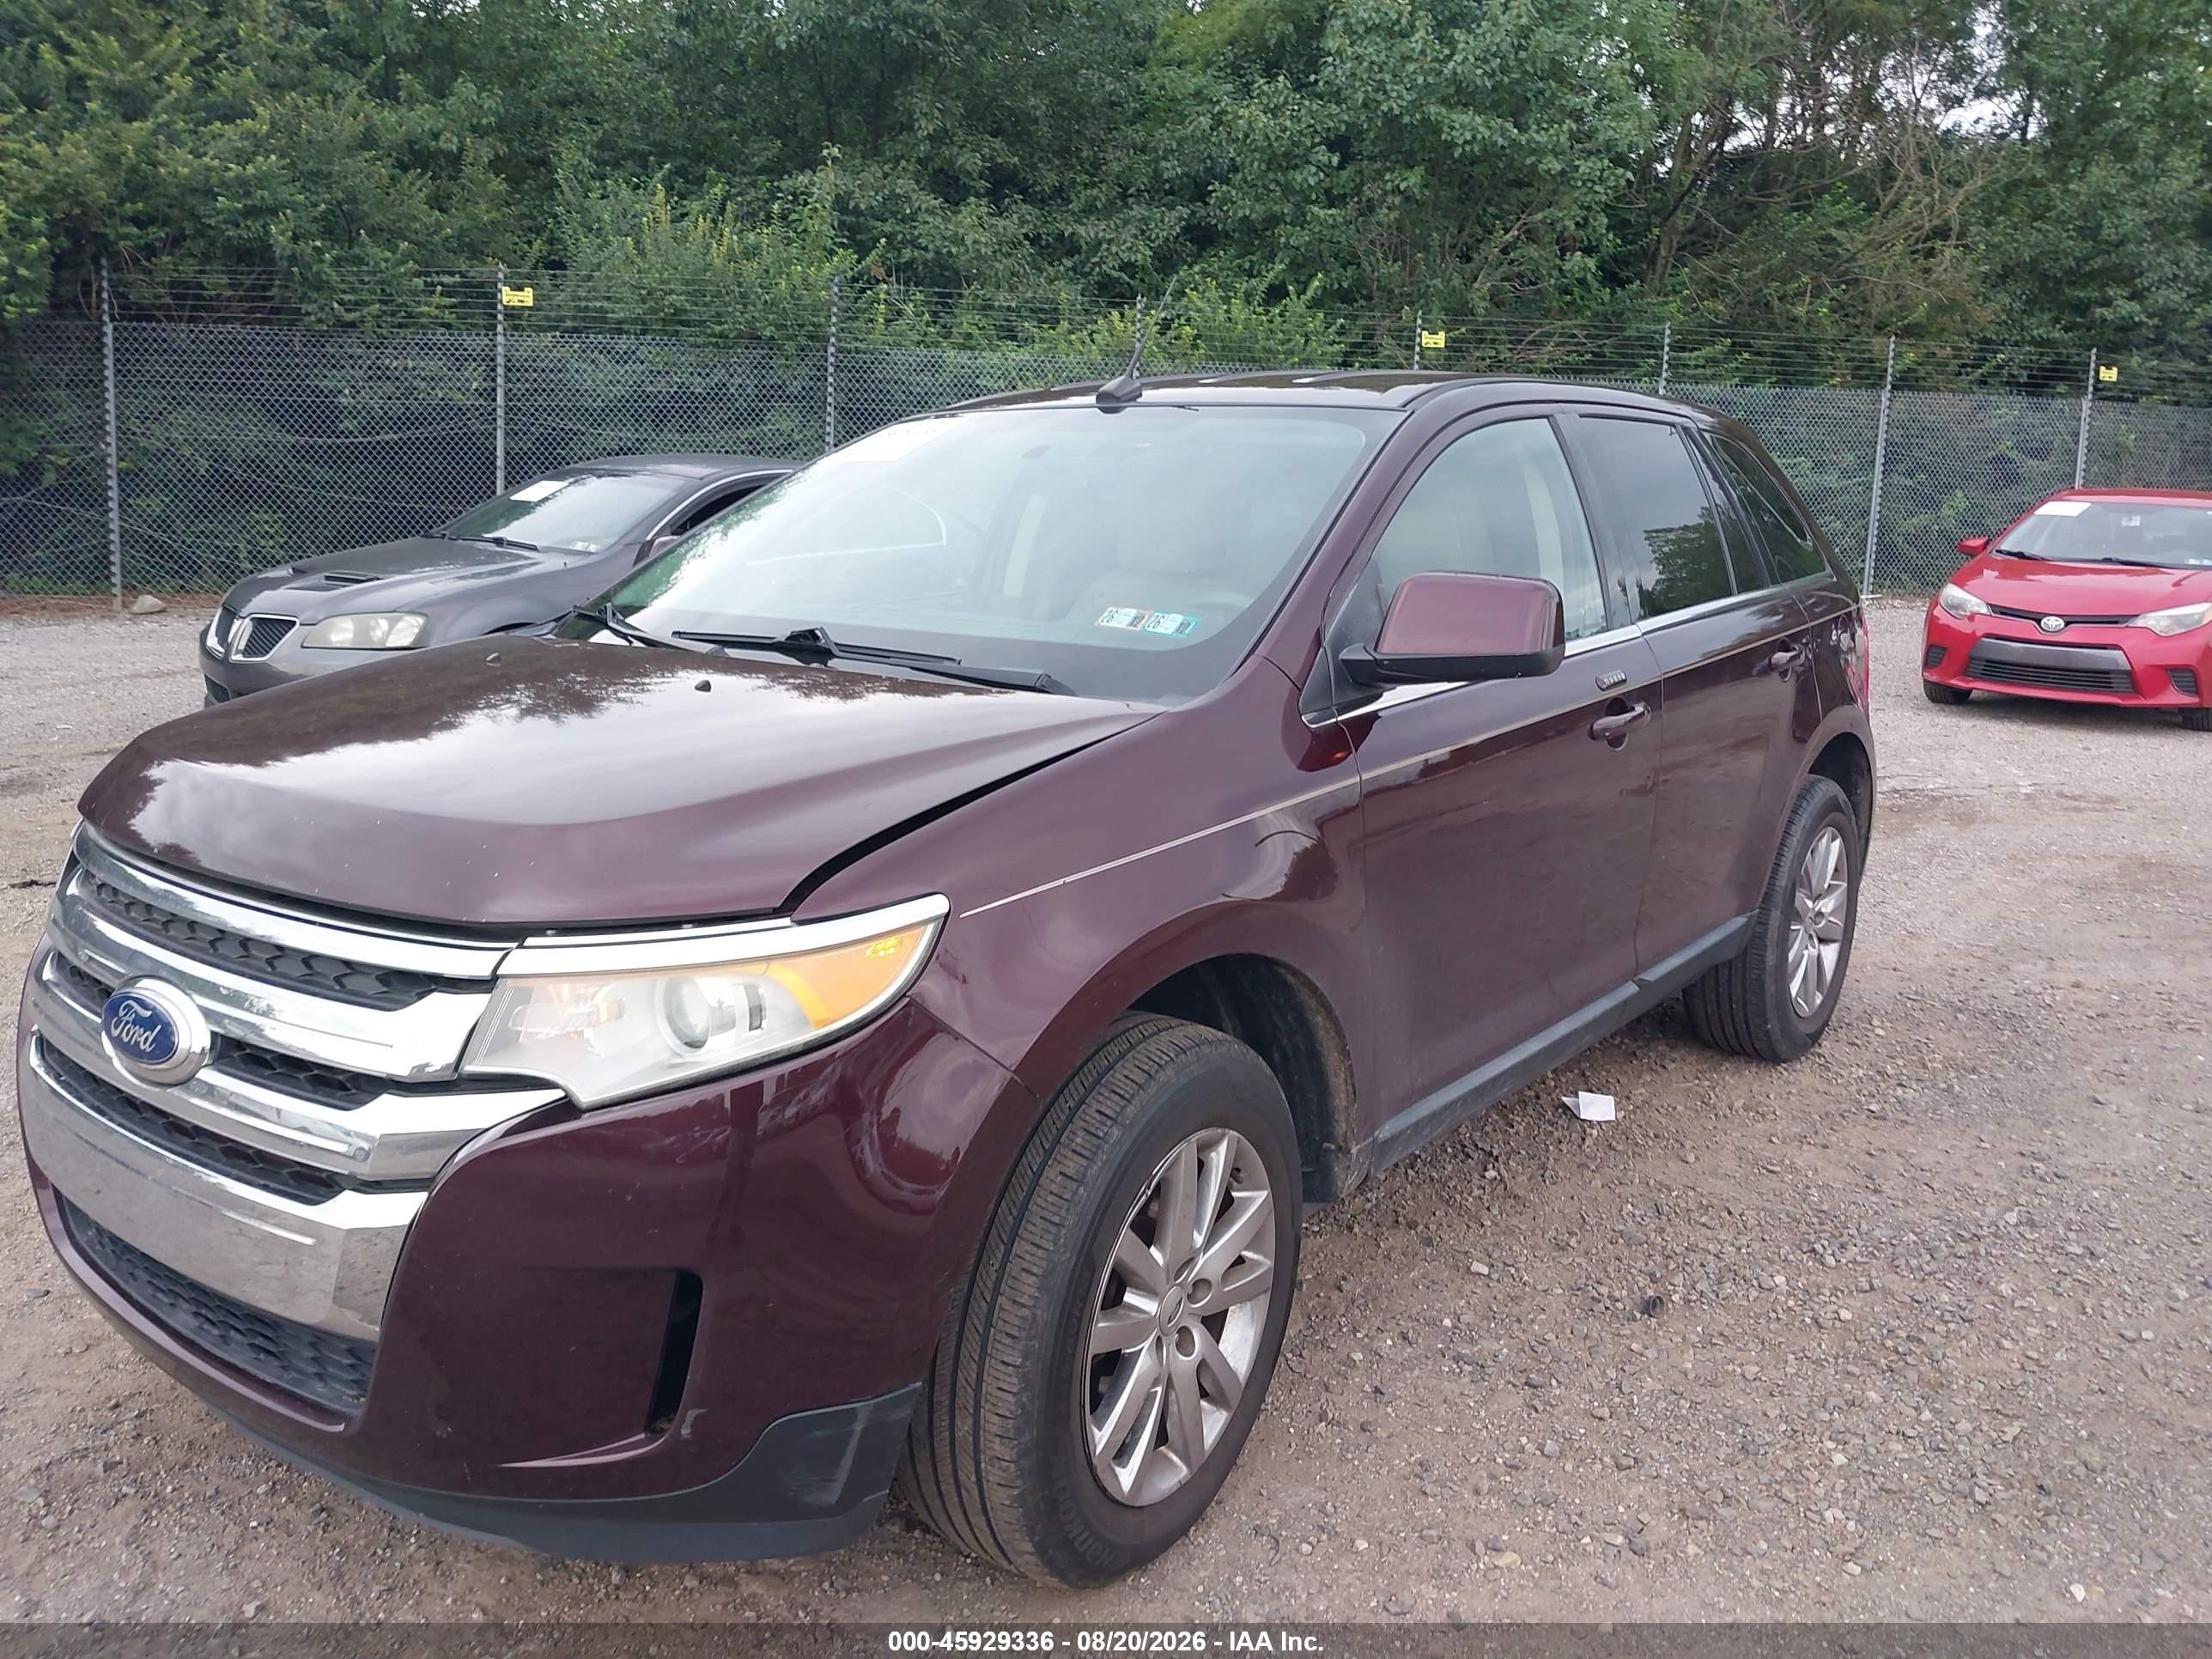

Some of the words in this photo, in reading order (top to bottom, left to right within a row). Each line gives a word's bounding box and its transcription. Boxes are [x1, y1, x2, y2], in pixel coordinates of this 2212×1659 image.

[1101, 609, 1119, 624] 26
[1146, 614, 1165, 629] 26
[110, 1000, 162, 1054] Ford
